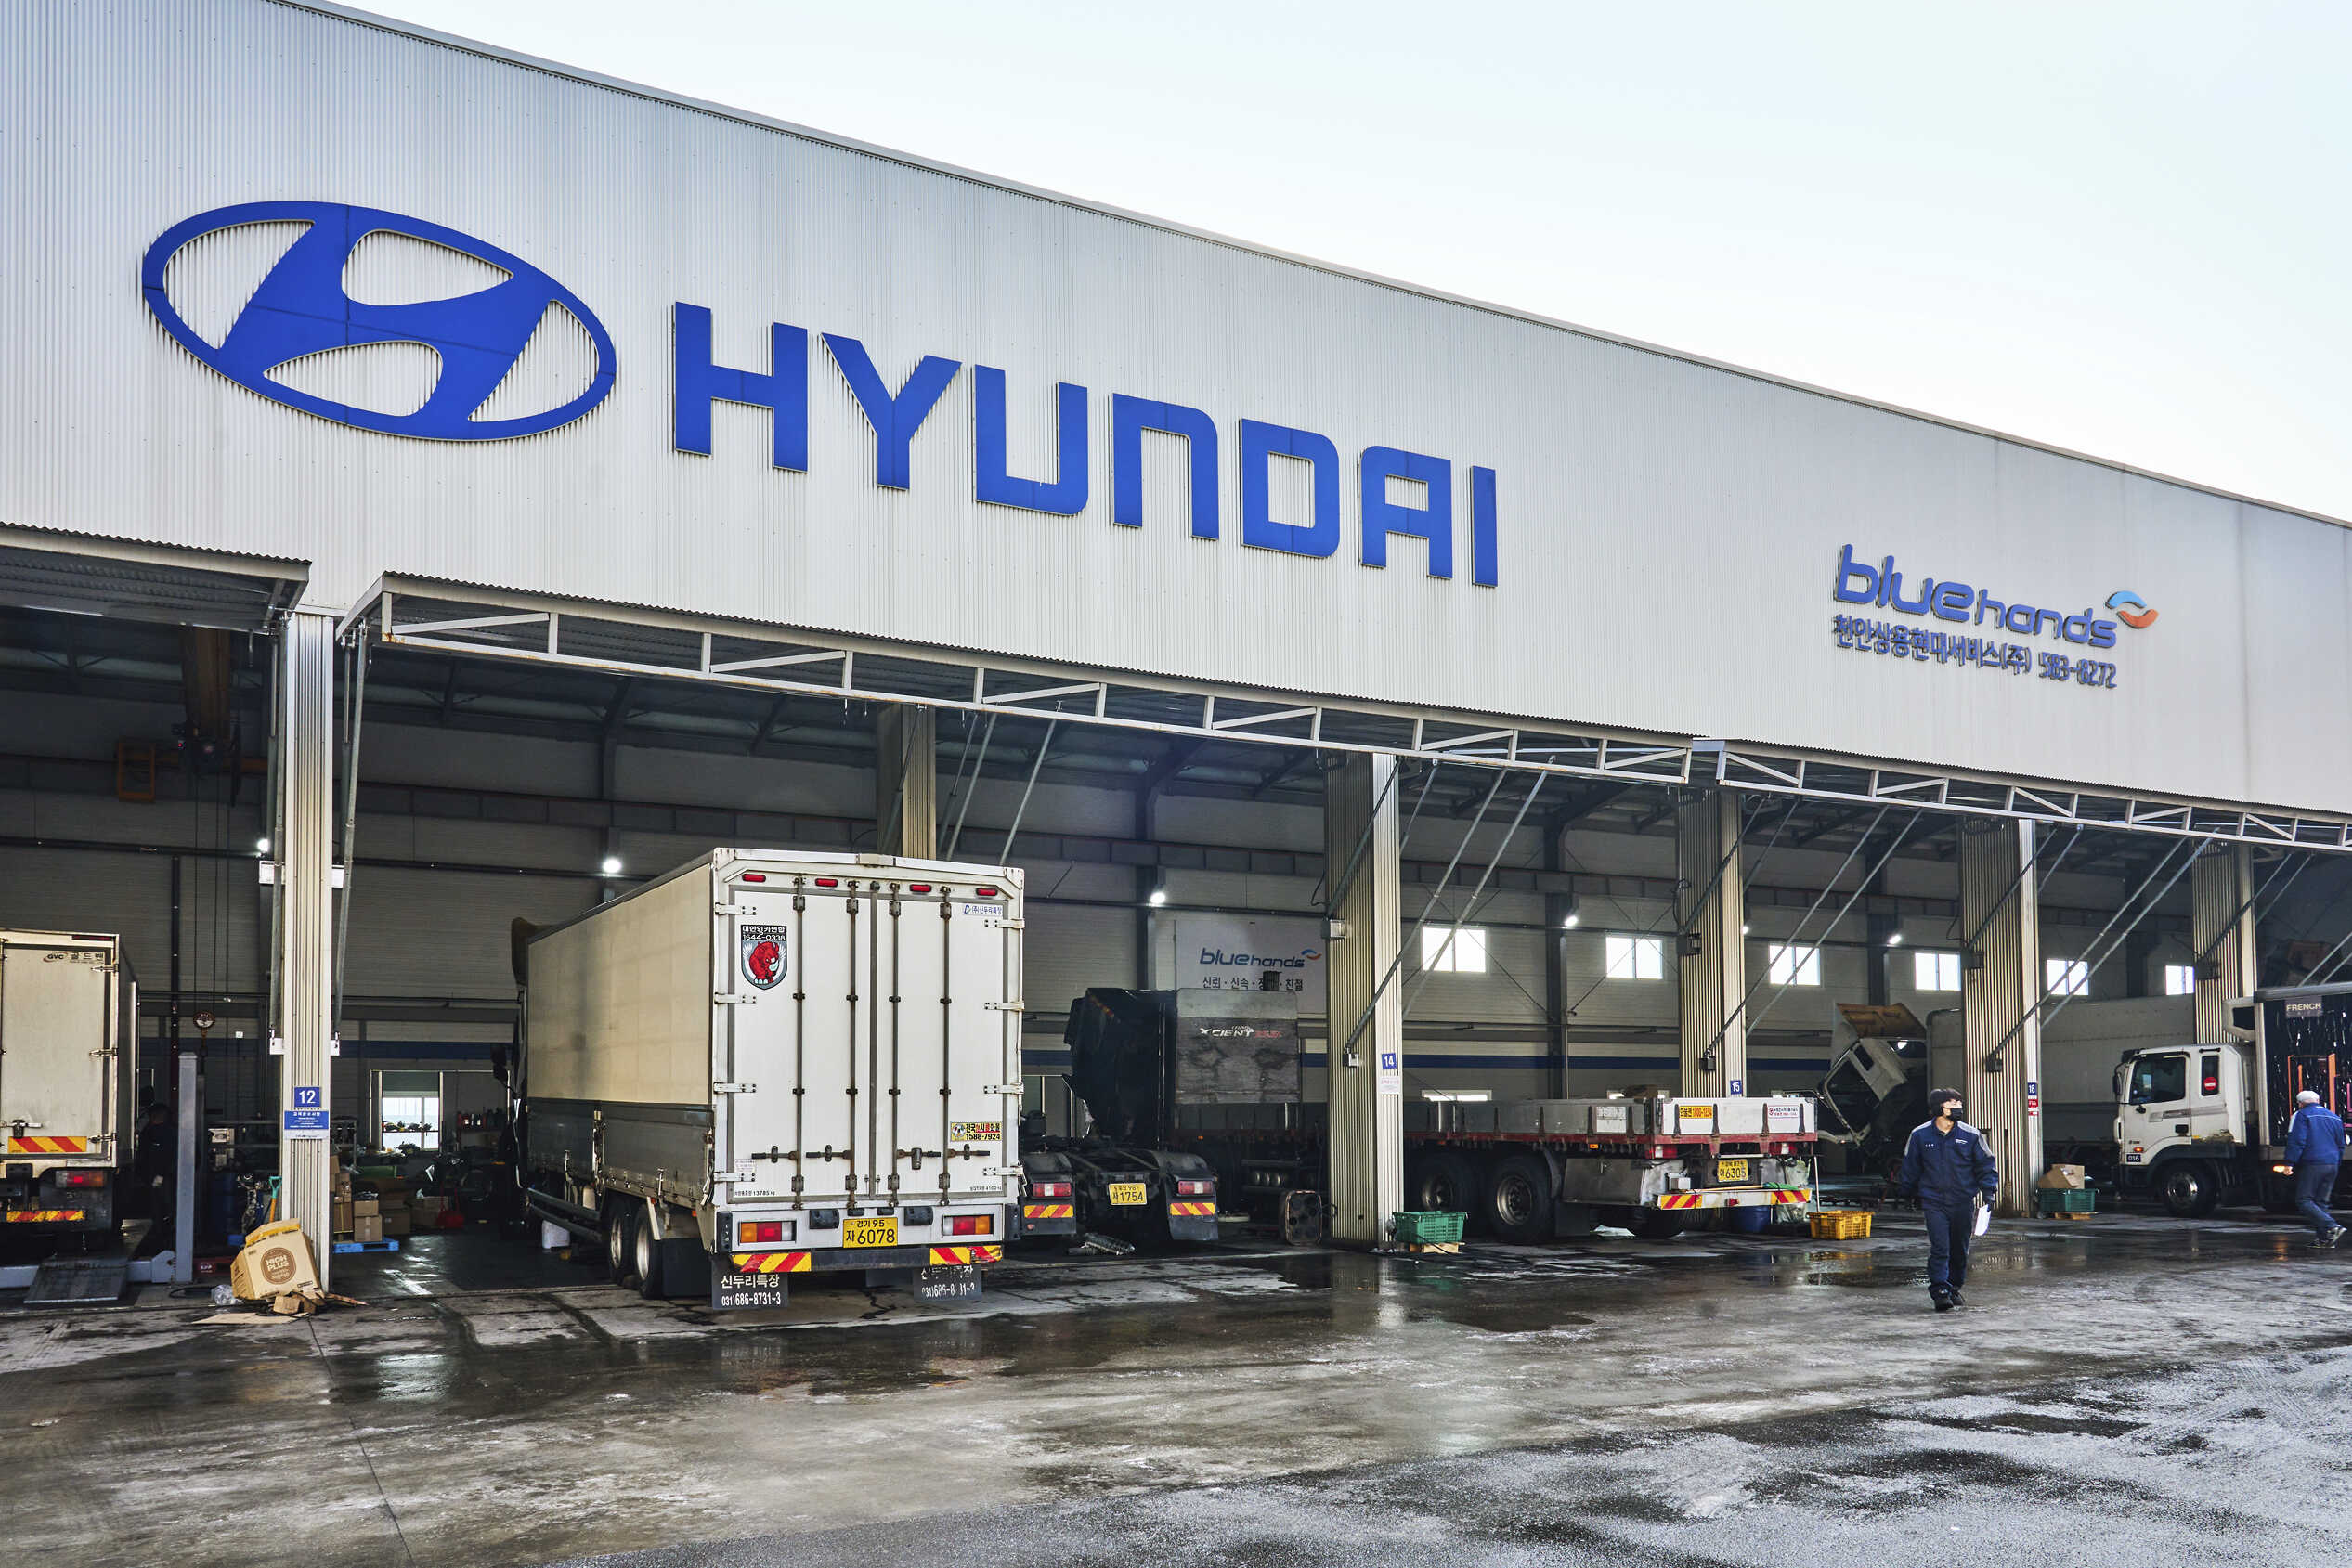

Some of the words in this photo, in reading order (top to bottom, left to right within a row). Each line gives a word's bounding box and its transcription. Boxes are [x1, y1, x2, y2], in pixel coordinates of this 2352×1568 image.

[675, 302, 1498, 587] HYUNDAI
[1835, 544, 2118, 648] bluehands
[1834, 615, 2032, 674] 천안상용현대서비스(주)
[2038, 652, 2117, 688] 583-8272
[1200, 948, 1305, 967] bluehands
[1202, 976, 1221, 989] 신뢰
[2286, 1003, 2321, 1011] FRENCH
[1384, 1055, 1395, 1067] 14
[1732, 1082, 1740, 1092] 15
[2028, 1084, 2035, 1094] 16
[299, 1090, 316, 1104] 12
[721, 1274, 780, 1289] 신두리특장
[721, 1291, 781, 1306] 031)686-8731~3
